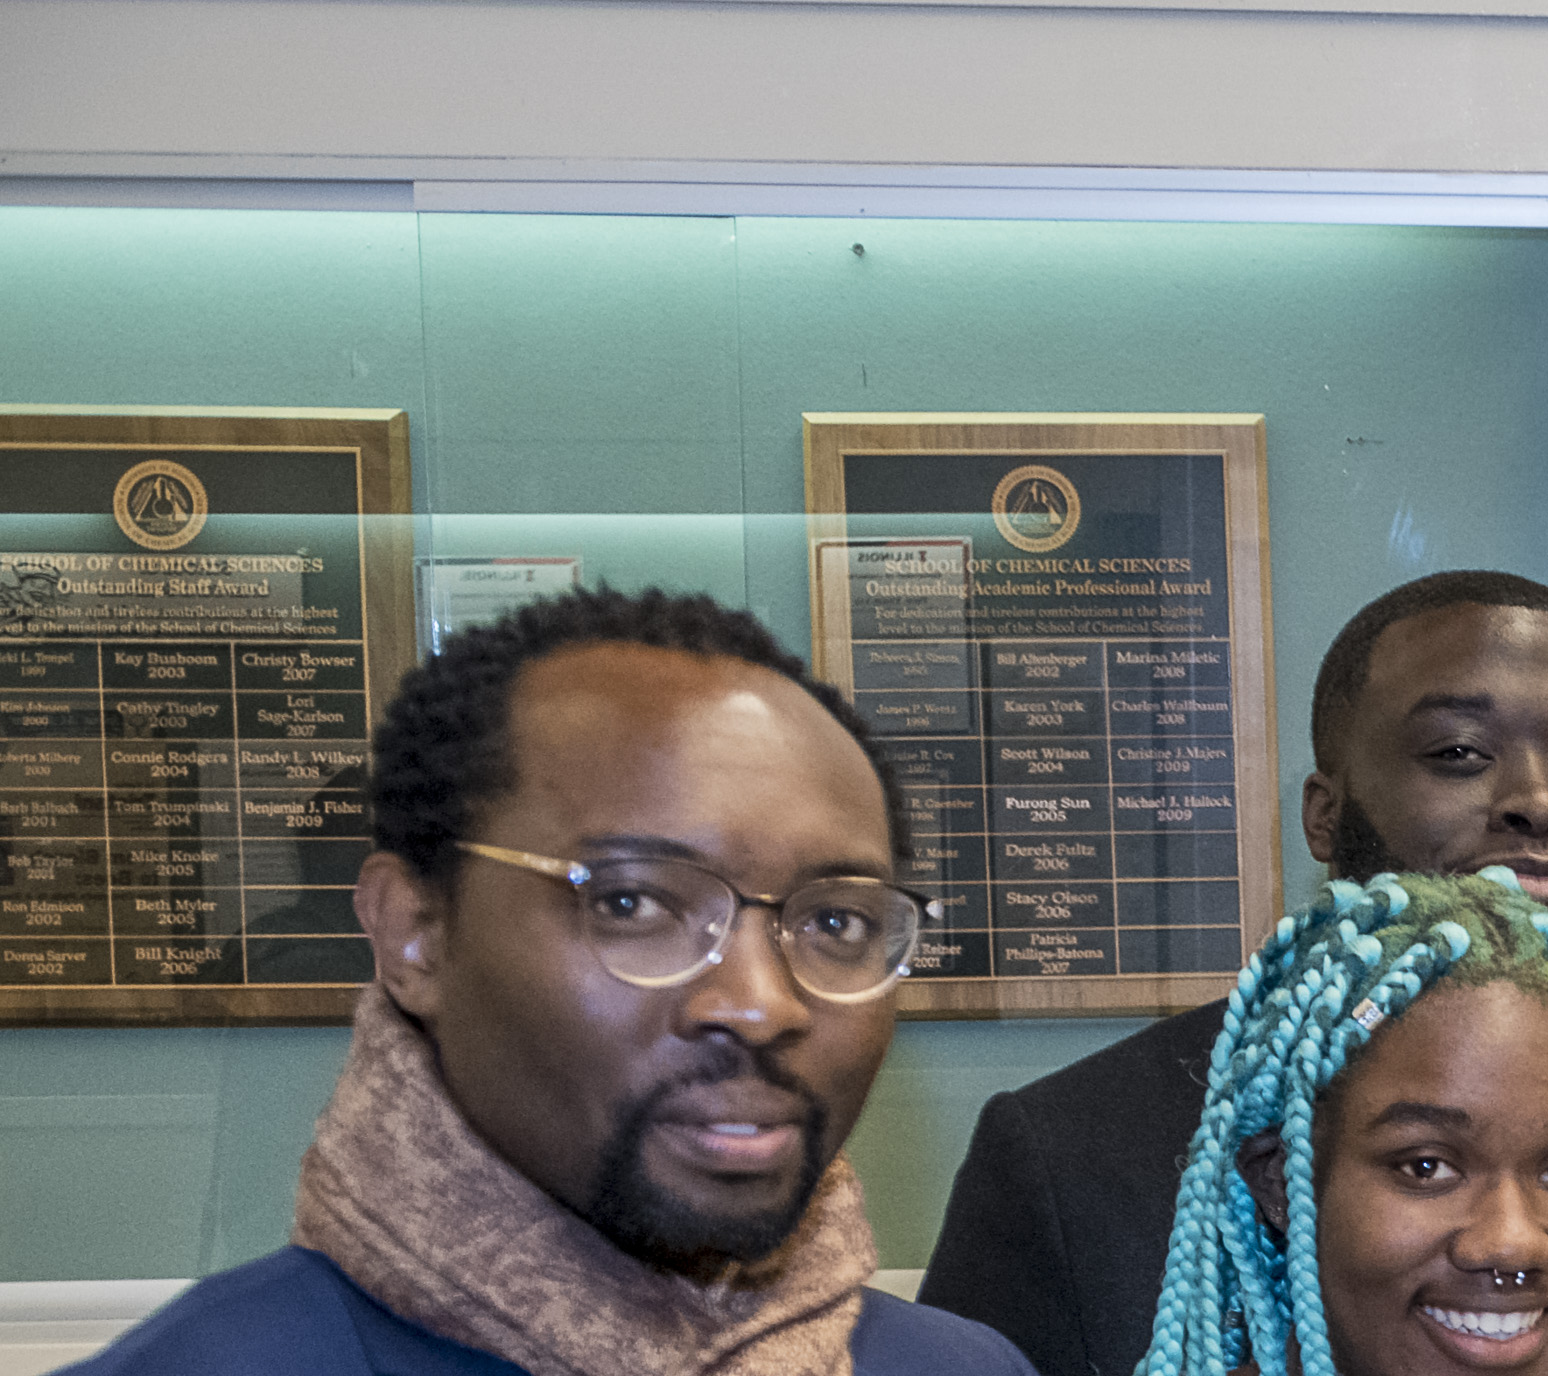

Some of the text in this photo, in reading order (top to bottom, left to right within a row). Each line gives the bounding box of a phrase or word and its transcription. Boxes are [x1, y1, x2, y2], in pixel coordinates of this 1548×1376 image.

[85, 557, 113, 572] OF
[118, 557, 217, 573] CHEMICAL
[226, 558, 324, 573] SCIENCES
[884, 559, 1191, 574] SCHOOL OF CHEMICAL SCIENCES
[56, 579, 270, 599] Outstanding Staff Award
[865, 580, 1212, 601] Outstanding Academic Professional Award
[114, 653, 142, 668] Kay
[241, 653, 356, 670] Christy Bowser
[1000, 747, 1090, 760] Scott Wilson
[1027, 761, 1064, 773] 2004
[244, 801, 304, 817] Benjamin
[324, 801, 363, 814] Fisher
[1005, 797, 1092, 812] Furong Sun
[286, 815, 323, 828] 2009
[1030, 810, 1067, 823] 2005
[1005, 844, 1095, 857] Derek Fultz
